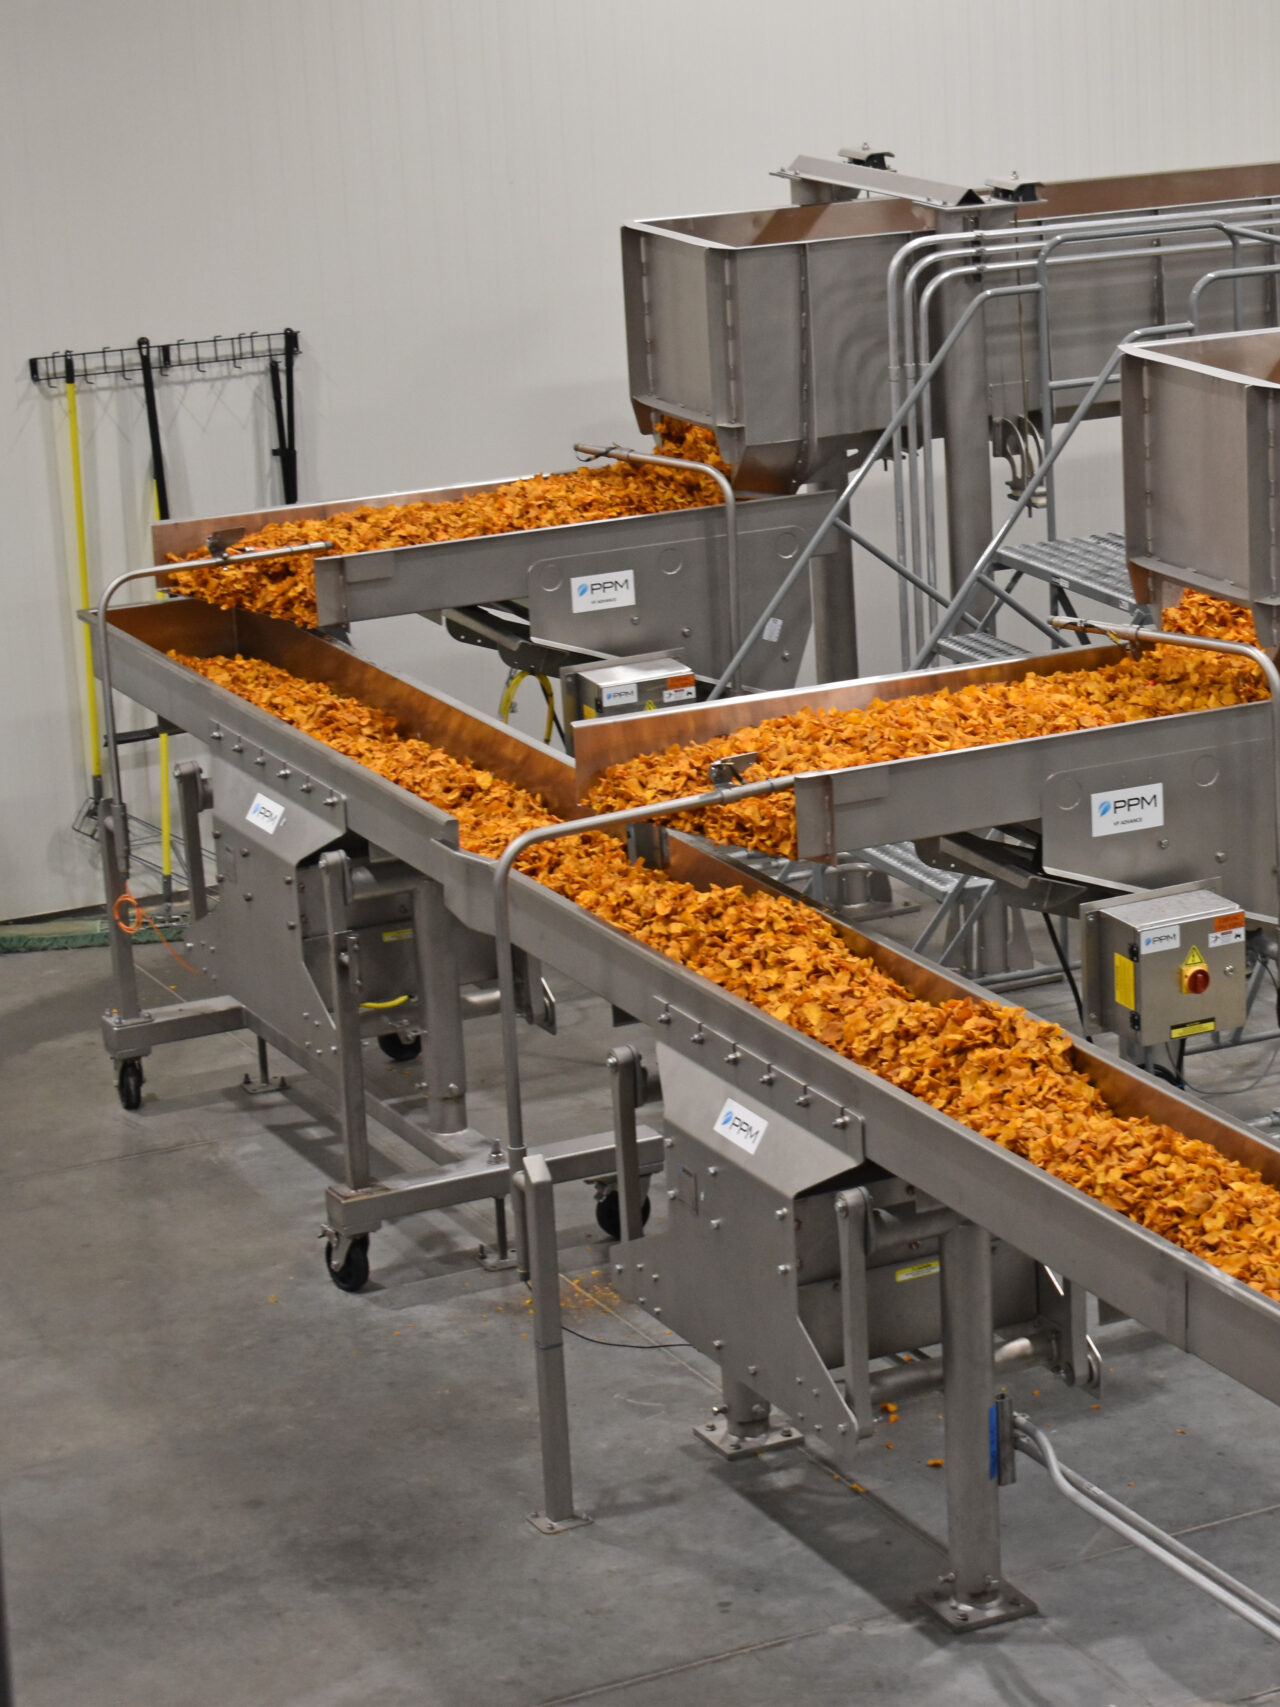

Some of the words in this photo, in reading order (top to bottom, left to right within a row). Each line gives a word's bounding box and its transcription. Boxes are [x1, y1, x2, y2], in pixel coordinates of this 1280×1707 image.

[590, 579, 629, 594] PPM
[612, 690, 634, 699] PPM
[1113, 794, 1157, 814] PPM
[259, 806, 278, 826] PPM
[1152, 933, 1176, 944] PPM
[729, 1116, 760, 1144] PPM
